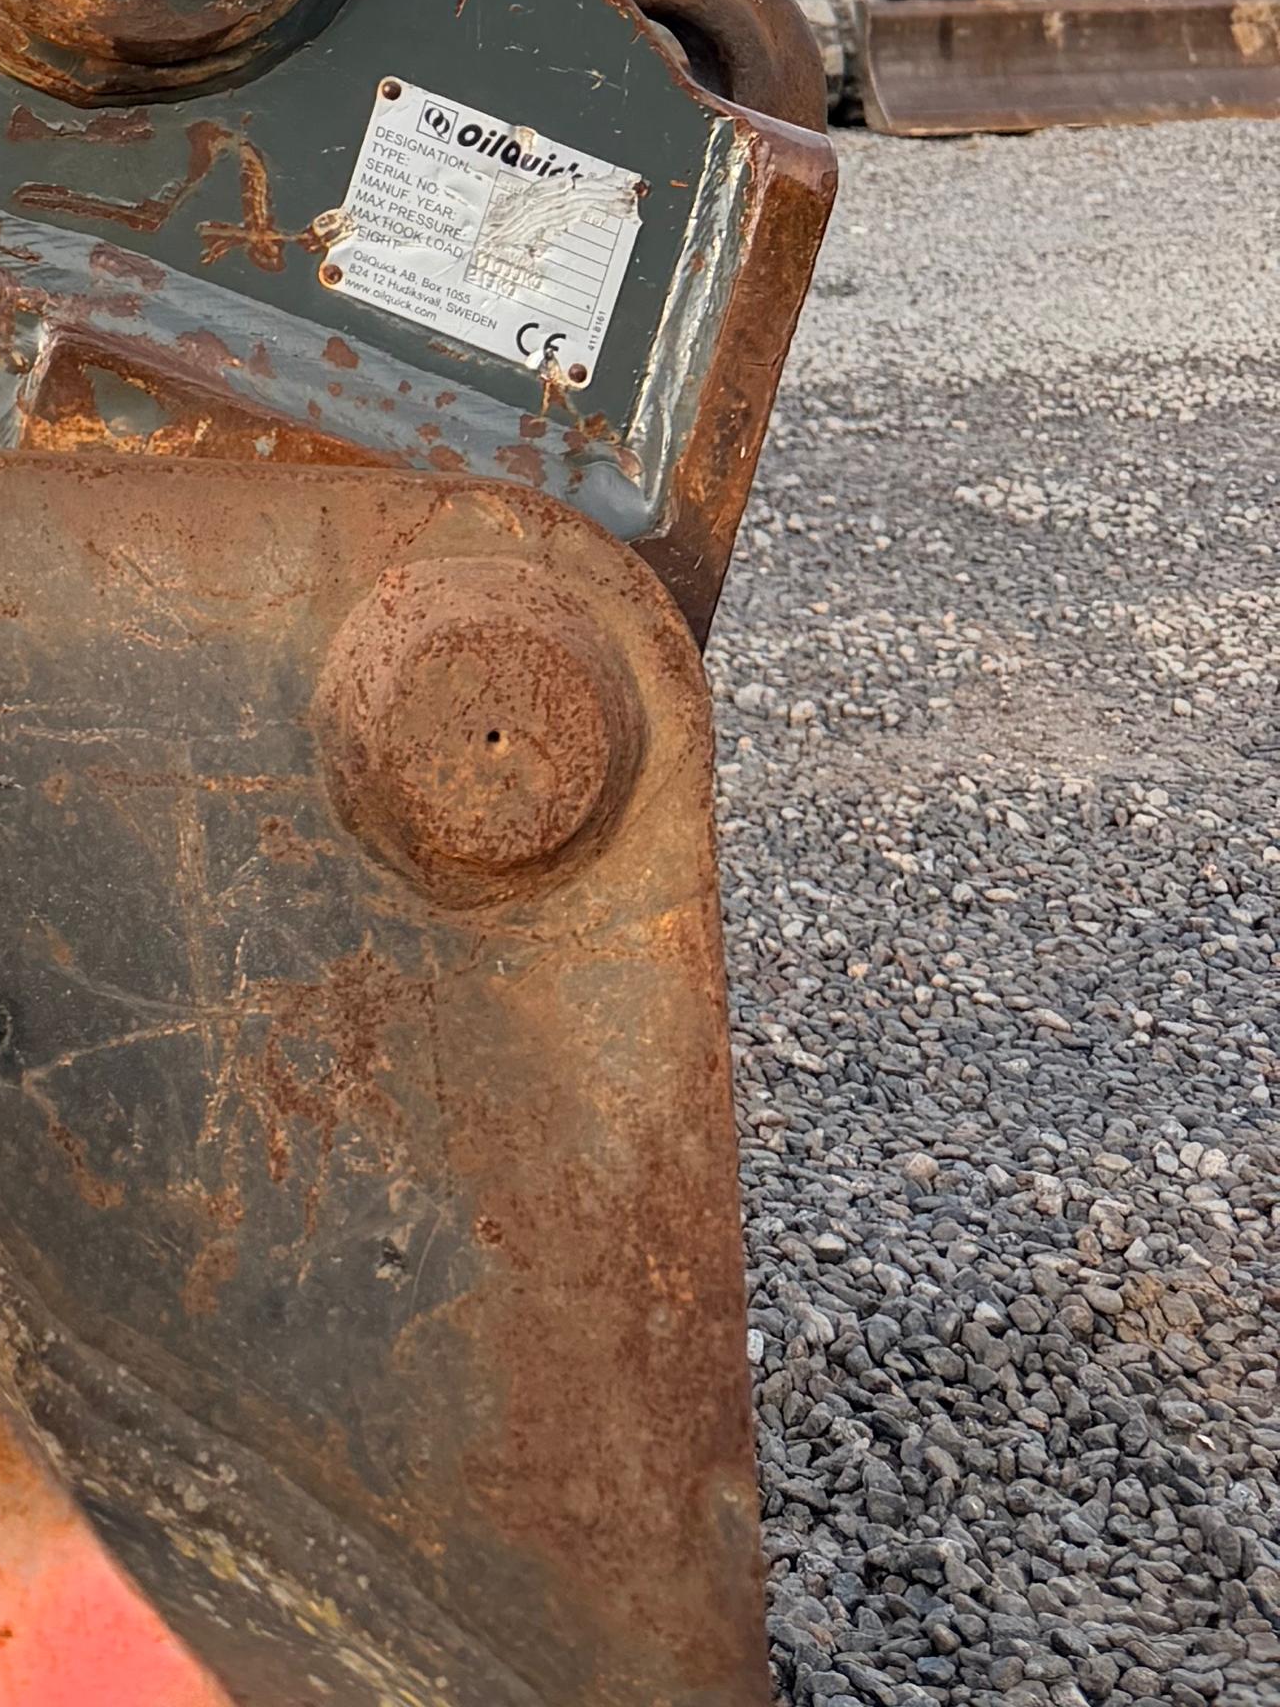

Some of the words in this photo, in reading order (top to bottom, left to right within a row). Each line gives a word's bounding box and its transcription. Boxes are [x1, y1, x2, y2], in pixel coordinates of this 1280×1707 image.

[371, 141, 411, 167] TYPE:
[365, 158, 414, 186] SERIAL
[355, 189, 385, 210] MAX
[416, 193, 457, 222] YEAR:
[352, 249, 398, 277] OilQuick
[421, 276, 442, 293] Box
[347, 261, 370, 279] 824
[372, 271, 386, 285] 12
[444, 301, 500, 332] SWEDEN
